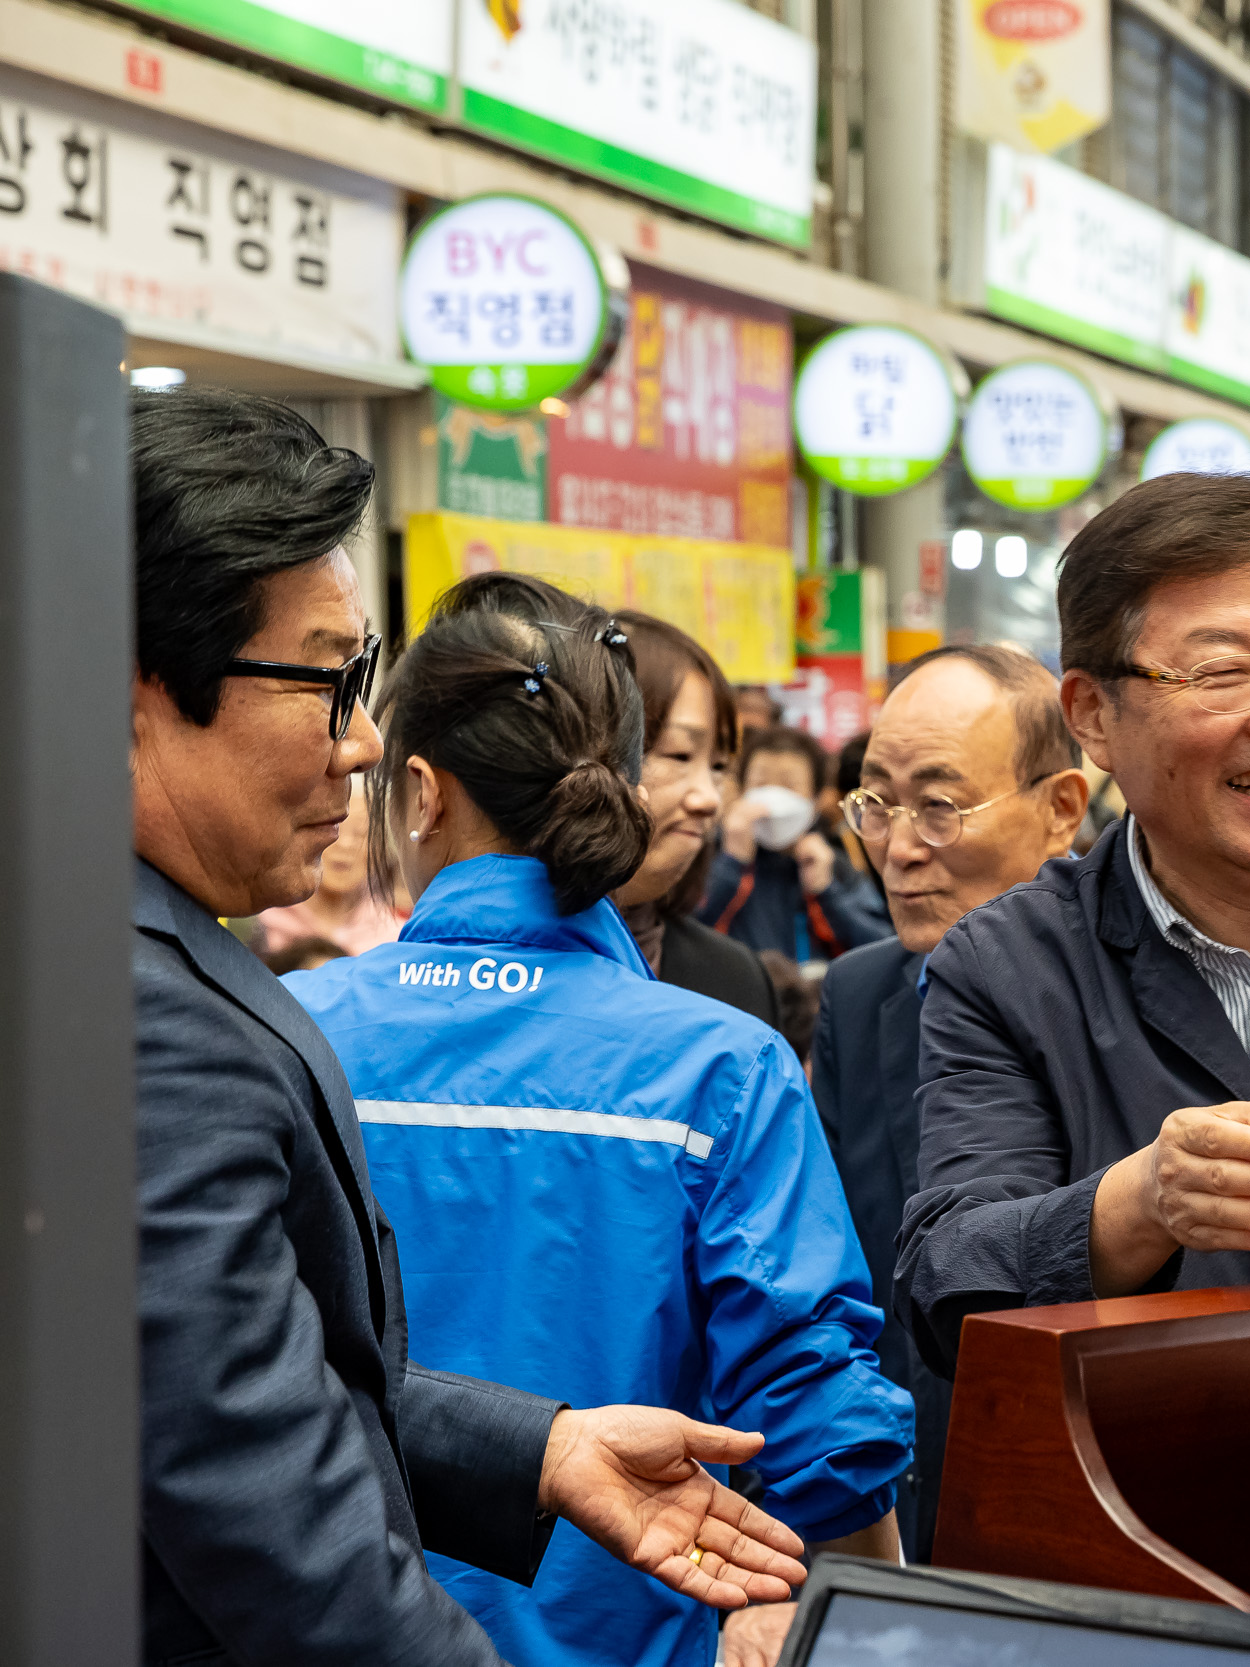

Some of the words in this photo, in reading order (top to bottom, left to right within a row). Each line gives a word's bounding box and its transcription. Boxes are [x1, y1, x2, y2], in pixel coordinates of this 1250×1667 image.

[166, 156, 331, 288] 직영점
[446, 230, 548, 277] BYC
[424, 290, 575, 348] 직영점
[400, 961, 460, 987] With
[468, 957, 544, 993] GO!
